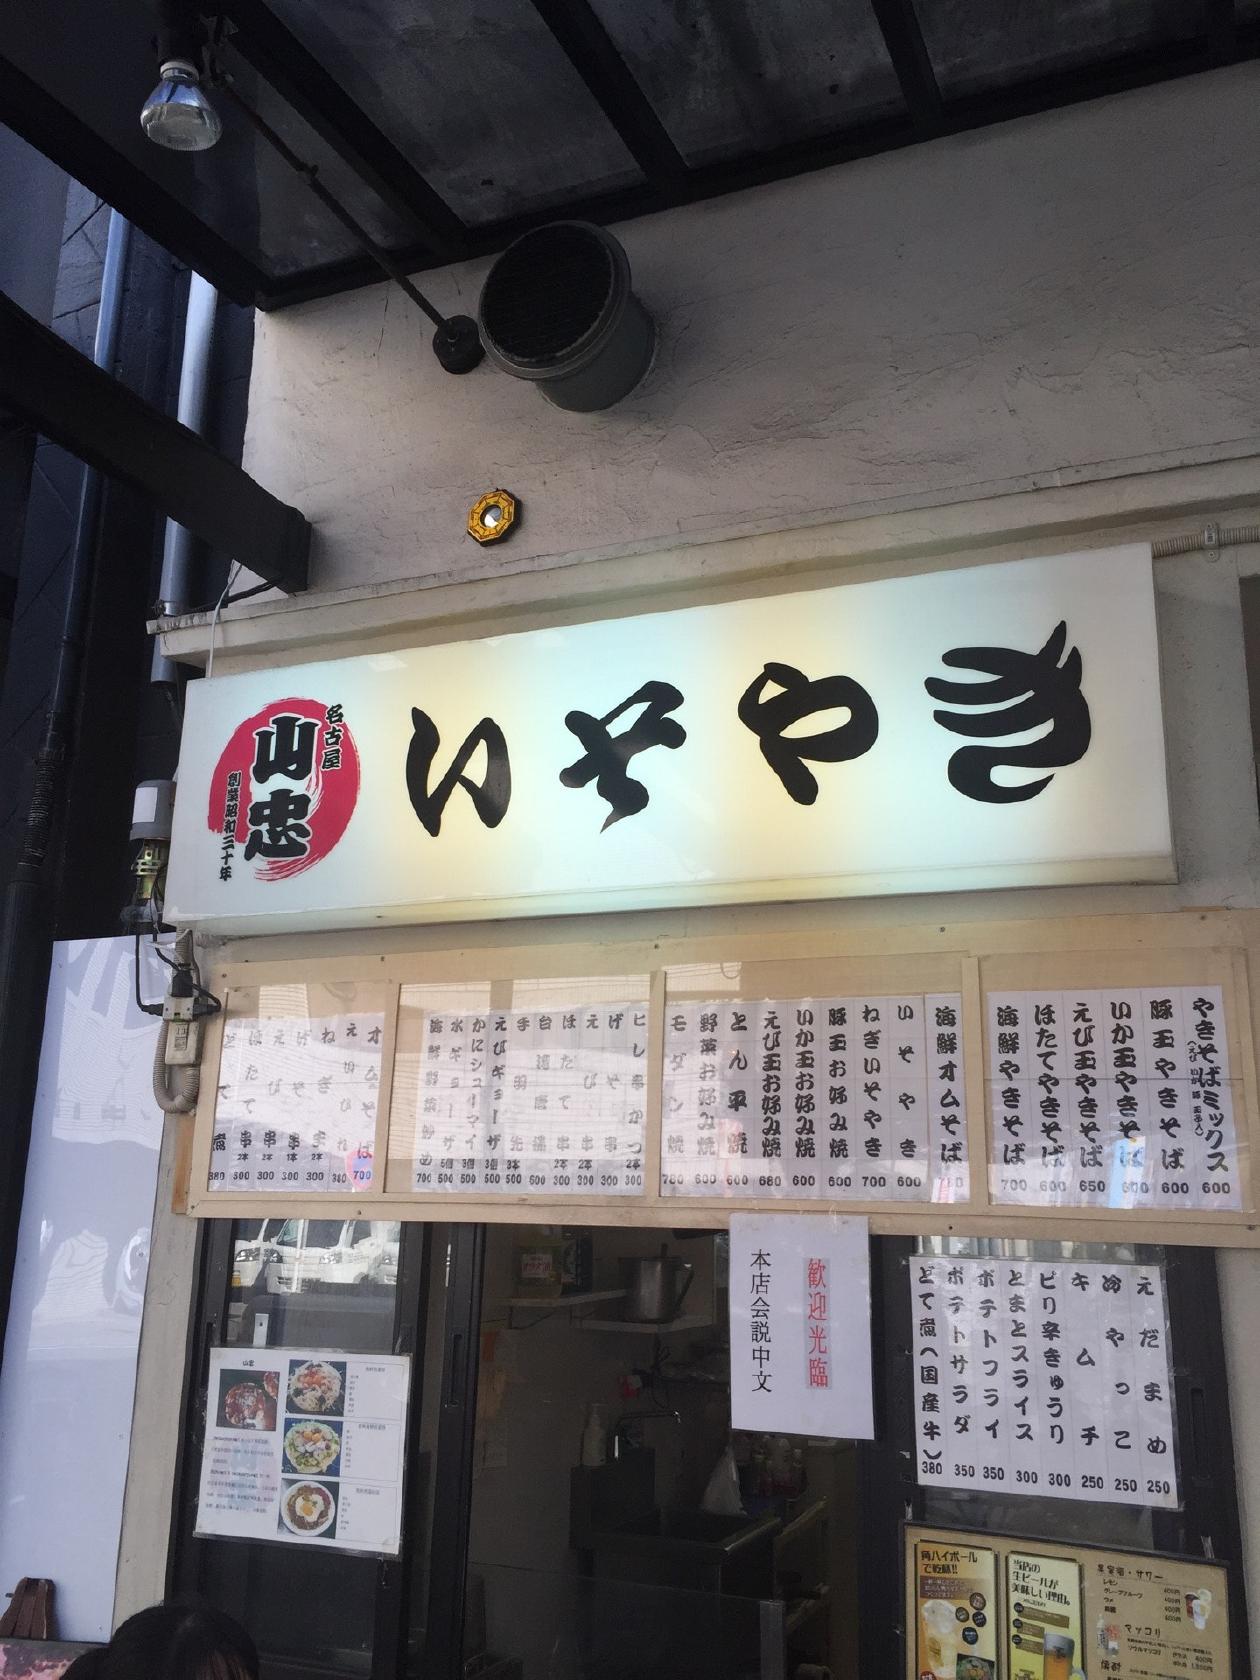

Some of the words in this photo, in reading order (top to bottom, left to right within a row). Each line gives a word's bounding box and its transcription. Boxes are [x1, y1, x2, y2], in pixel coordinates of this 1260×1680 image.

[406, 619, 1091, 837] いそやき
[322, 703, 344, 770] 名古屋
[245, 716, 319, 860] 山忠
[218, 771, 242, 882] 創業昭和三十年
[727, 1012, 748, 1155] とん平焼
[761, 1011, 782, 1158] えび玉お好み焼
[794, 1009, 815, 1158] いか玉お好み焼
[828, 1008, 849, 1158] 豚玉お好み焼
[862, 1005, 882, 1158] ねぎいそやき
[897, 1005, 917, 1158] いそやき
[935, 1006, 963, 1163] 海鮮オムそば
[997, 1005, 1026, 1165] 海鮮やきそば
[1035, 1004, 1064, 1167] ほたてやきそば
[1072, 1002, 1103, 1168] えび玉やきそば
[1110, 1001, 1144, 1168] いか玉やきそば
[1150, 999, 1184, 1170] 豚玉やきそば
[1192, 997, 1229, 1172] やきそばミックス
[237, 1153, 249, 1162] 2本
[286, 1153, 298, 1162] 1本
[311, 1153, 323, 1162] 2本
[554, 1159, 567, 1169] 2本
[578, 1159, 592, 1170] 2本
[626, 1159, 641, 1170] 2本
[257, 1170, 274, 1180] 300
[306, 1171, 324, 1181] 300
[353, 1170, 371, 1180] 700
[417, 1174, 432, 1183] 700
[438, 1174, 453, 1184] 500
[460, 1174, 476, 1184] 500
[484, 1173, 500, 1184] 500
[505, 1174, 522, 1184] 500
[553, 1175, 570, 1185] 300
[577, 1175, 594, 1185] 300
[601, 1175, 618, 1186] 300
[625, 1175, 642, 1185] 300
[726, 1175, 748, 1186] 600
[759, 1176, 781, 1187] 680
[792, 1175, 815, 1187] 600
[828, 1176, 851, 1187] 600
[862, 1176, 886, 1187] 700
[897, 1176, 922, 1187] 600
[1001, 1179, 1027, 1191] 700
[1079, 1180, 1106, 1193] 650
[1161, 1181, 1189, 1194] 600
[1202, 1181, 1231, 1194] 600
[750, 1249, 772, 1393] 本店会説中文
[807, 1258, 829, 1388] 歓迎光臨
[947, 1267, 970, 1433] ポテトサラダ
[977, 1269, 1000, 1438] ポテトフライ
[1008, 1269, 1034, 1440] とまとスライス
[1040, 1272, 1064, 1444] ピリ辛きゅうり
[1072, 1272, 1099, 1445] キムチ
[1136, 1276, 1167, 1454] えだまめ
[922, 1462, 943, 1475] 380
[954, 1464, 975, 1478] 350
[983, 1467, 1005, 1480] 350
[1015, 1470, 1038, 1484] 300
[1048, 1473, 1071, 1487] 300
[1081, 1475, 1104, 1489] 250
[1114, 1478, 1138, 1492] 250
[1146, 1480, 1170, 1494] 250
[1124, 1624, 1161, 1638] マッコリ
